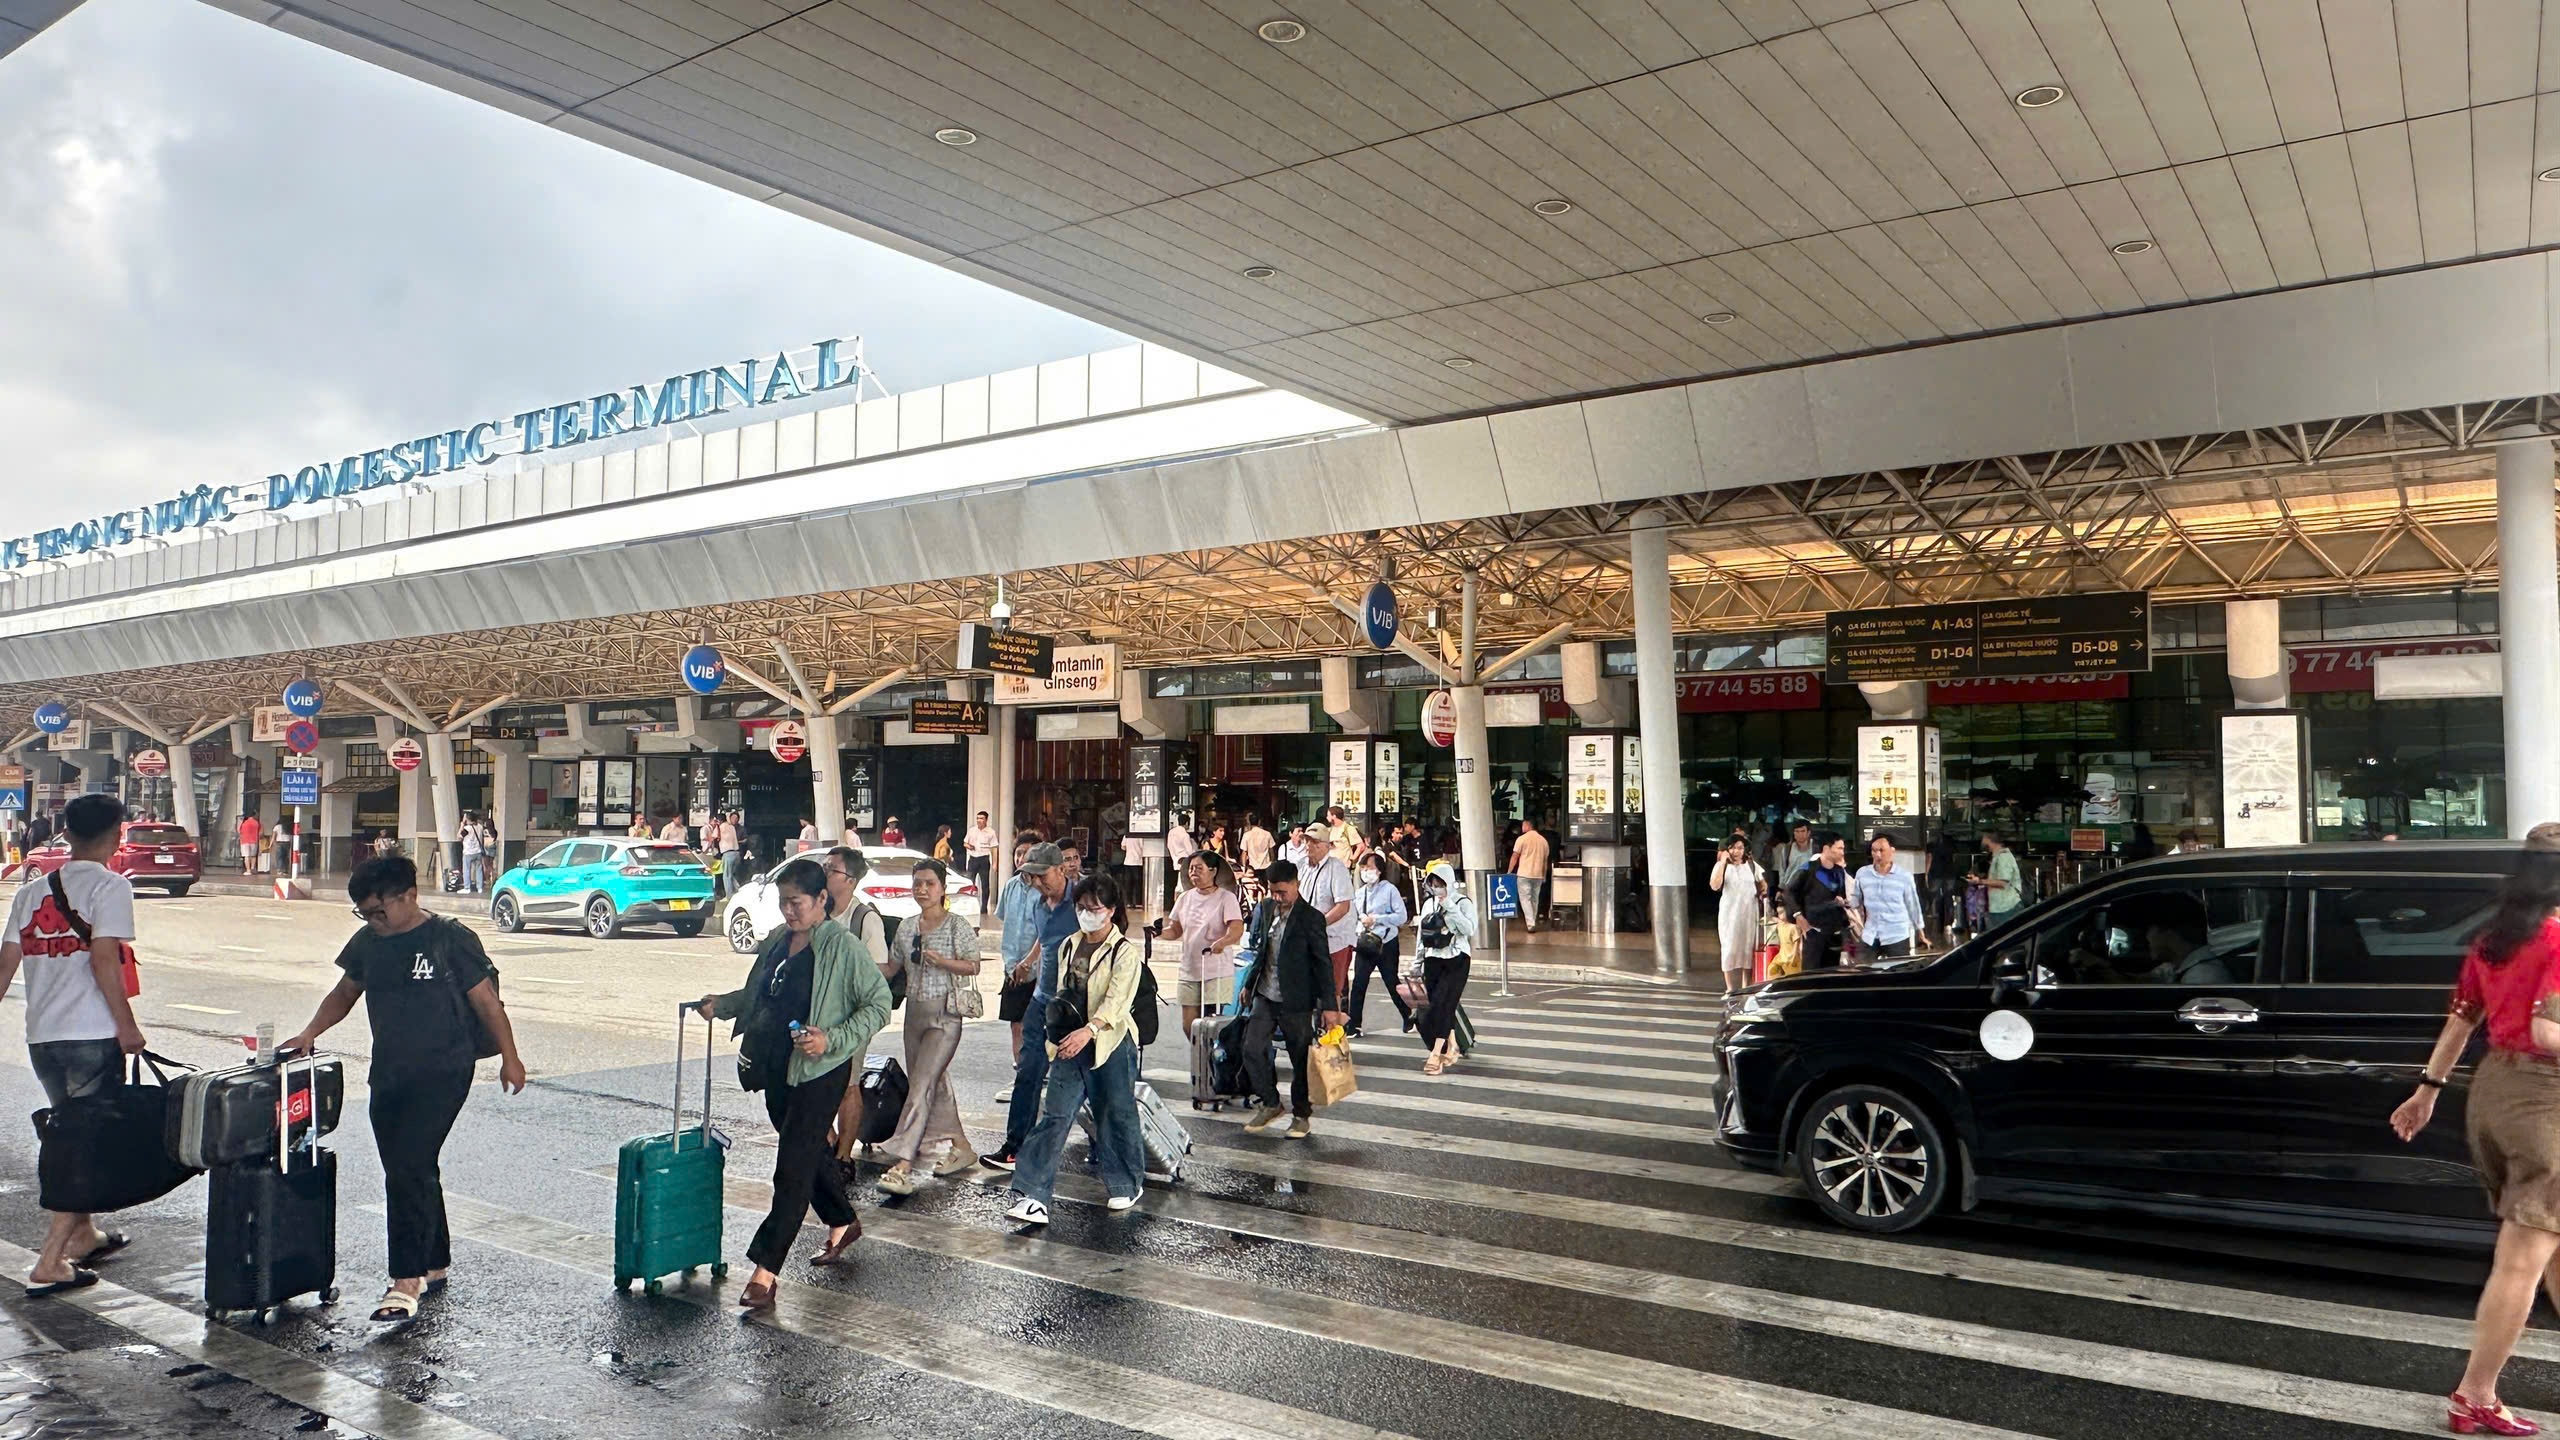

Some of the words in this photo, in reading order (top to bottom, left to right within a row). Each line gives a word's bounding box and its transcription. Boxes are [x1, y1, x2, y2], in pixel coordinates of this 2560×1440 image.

[33, 511, 134, 561] TRONG
[140, 484, 239, 538] NƯỚC
[266, 420, 502, 511] DOMESTIC
[514, 339, 860, 454] TERMINAL
[1372, 607, 1393, 630] VIB
[1931, 617, 1974, 631] A1-A3
[1931, 646, 1973, 660] D1-D4
[690, 664, 714, 679] VIB
[1051, 654, 1104, 672] mtamin
[2303, 652, 2340, 673] 77
[1690, 680, 1715, 697] 77
[1718, 679, 1744, 696] 44
[1750, 677, 1775, 695] 55
[1781, 676, 1808, 693] 88
[290, 695, 314, 706] VIB
[39, 715, 61, 725] VIB
[962, 703, 974, 721] A
[412, 953, 433, 979] LA
